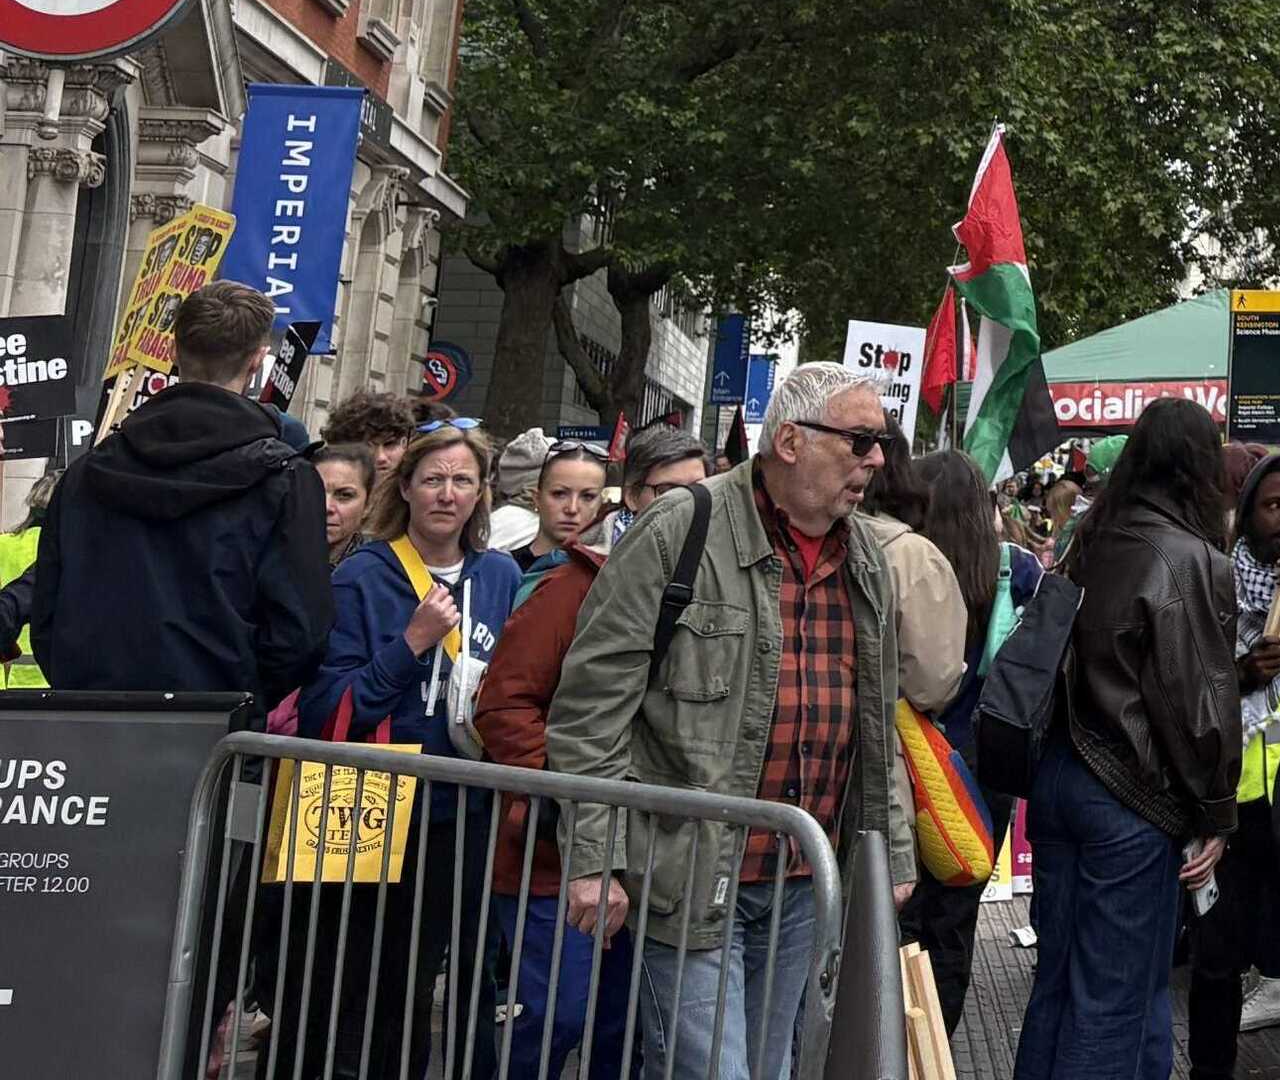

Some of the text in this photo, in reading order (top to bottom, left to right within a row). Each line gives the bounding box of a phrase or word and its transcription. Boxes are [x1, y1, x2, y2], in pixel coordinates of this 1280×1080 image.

[0, 357, 68, 386] tine
[1050, 388, 1168, 422] ociali
[0, 795, 109, 825] ANCE
[41, 876, 90, 894] 12.00
